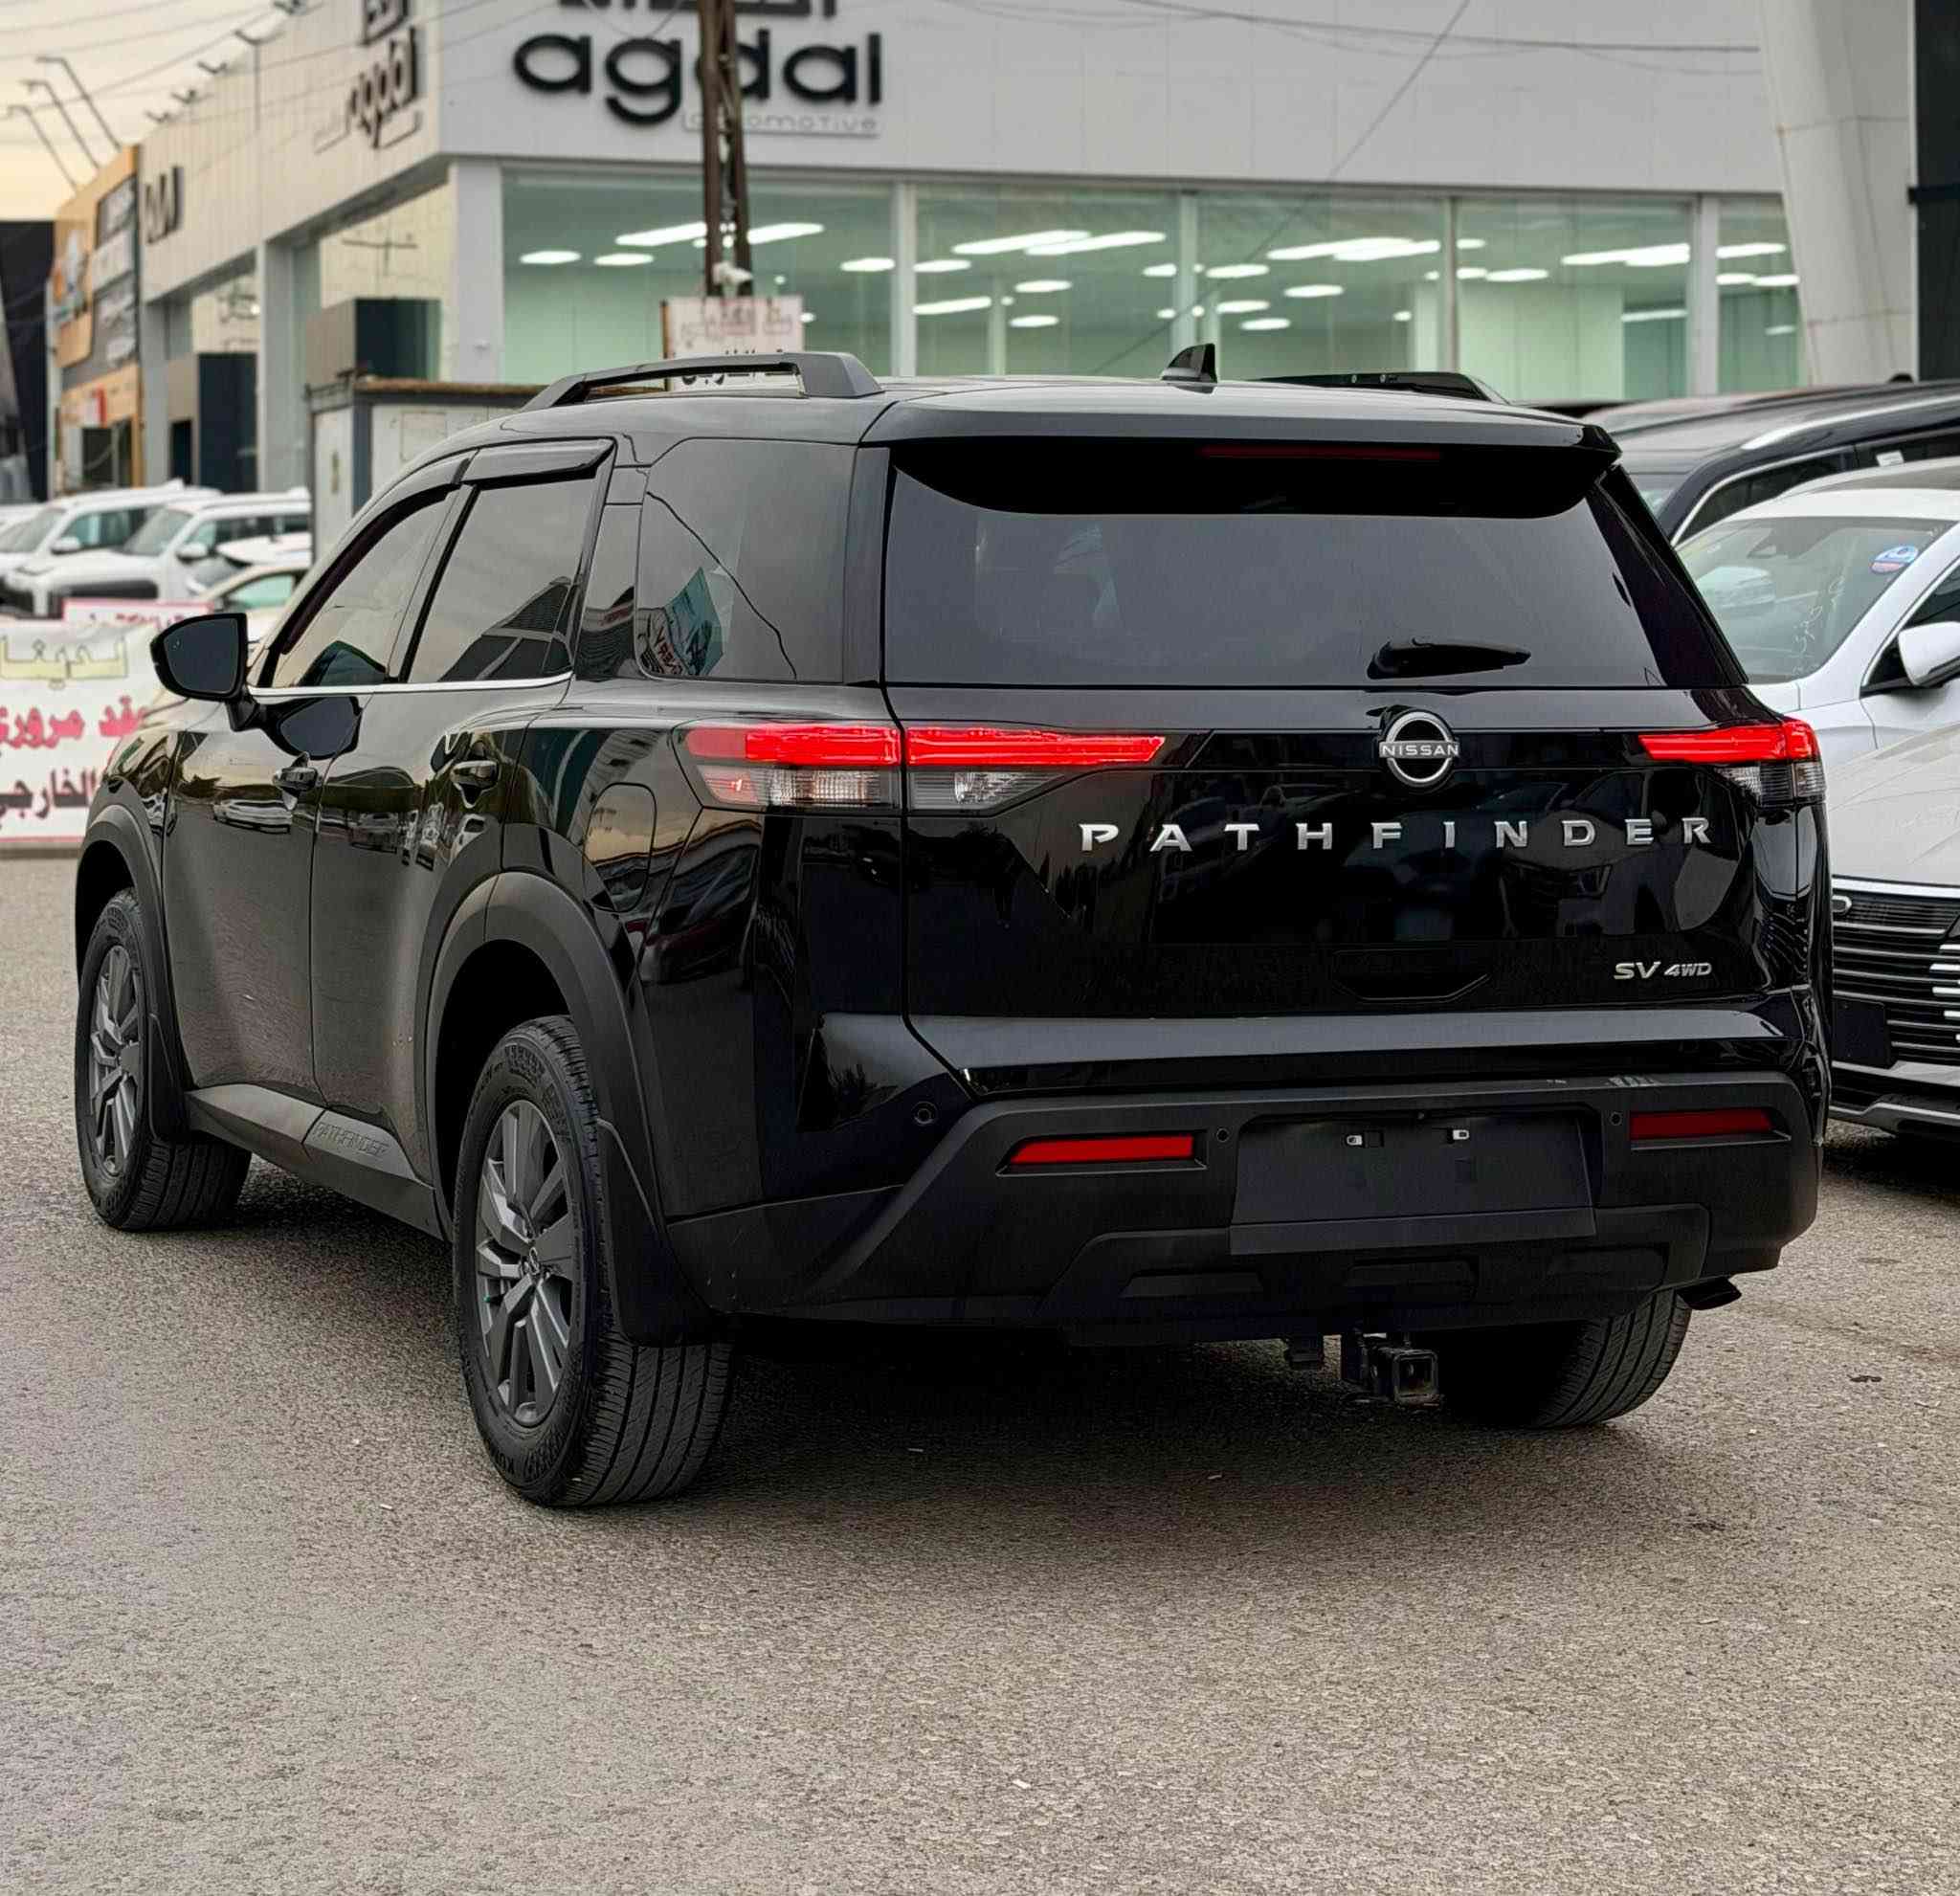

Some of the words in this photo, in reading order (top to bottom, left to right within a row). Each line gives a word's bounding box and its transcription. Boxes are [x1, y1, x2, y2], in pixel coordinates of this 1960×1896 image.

[513, 28, 882, 126] agdal
[1382, 745, 1459, 757] NISSAN
[1079, 816, 1711, 853] PATHFINDER
[1614, 961, 1661, 980] SV
[1663, 962, 1712, 977] 4WD
